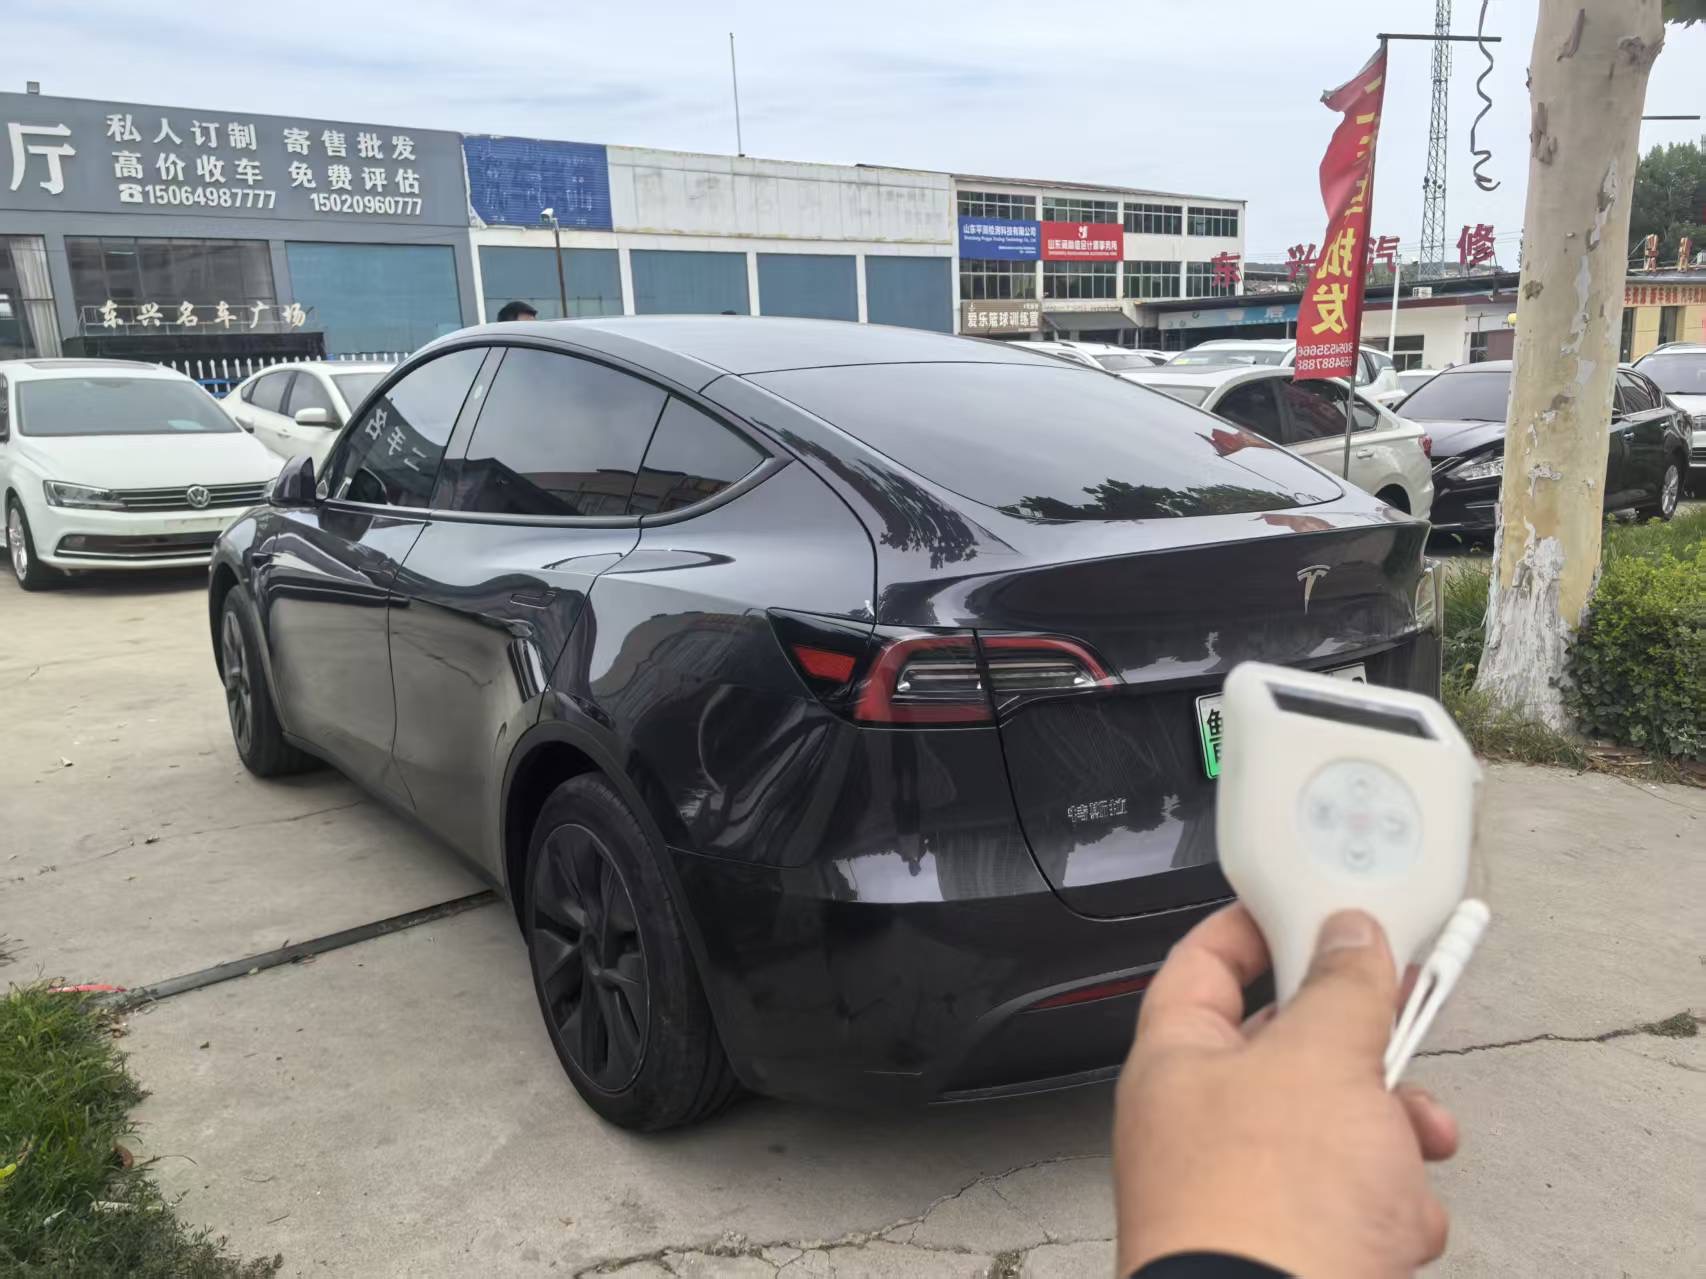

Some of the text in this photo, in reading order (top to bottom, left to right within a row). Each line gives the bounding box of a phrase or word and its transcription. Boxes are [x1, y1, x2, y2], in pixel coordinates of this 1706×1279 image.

[106, 113, 416, 161] 私人订制 寄售批发
[8, 122, 76, 195] 厅
[112, 150, 420, 194] 高价收车 免费评估
[145, 184, 422, 216] 15064987777 15020960777
[100, 300, 308, 329] 东兴名车广场
[1067, 798, 1128, 822] 特斯拉
